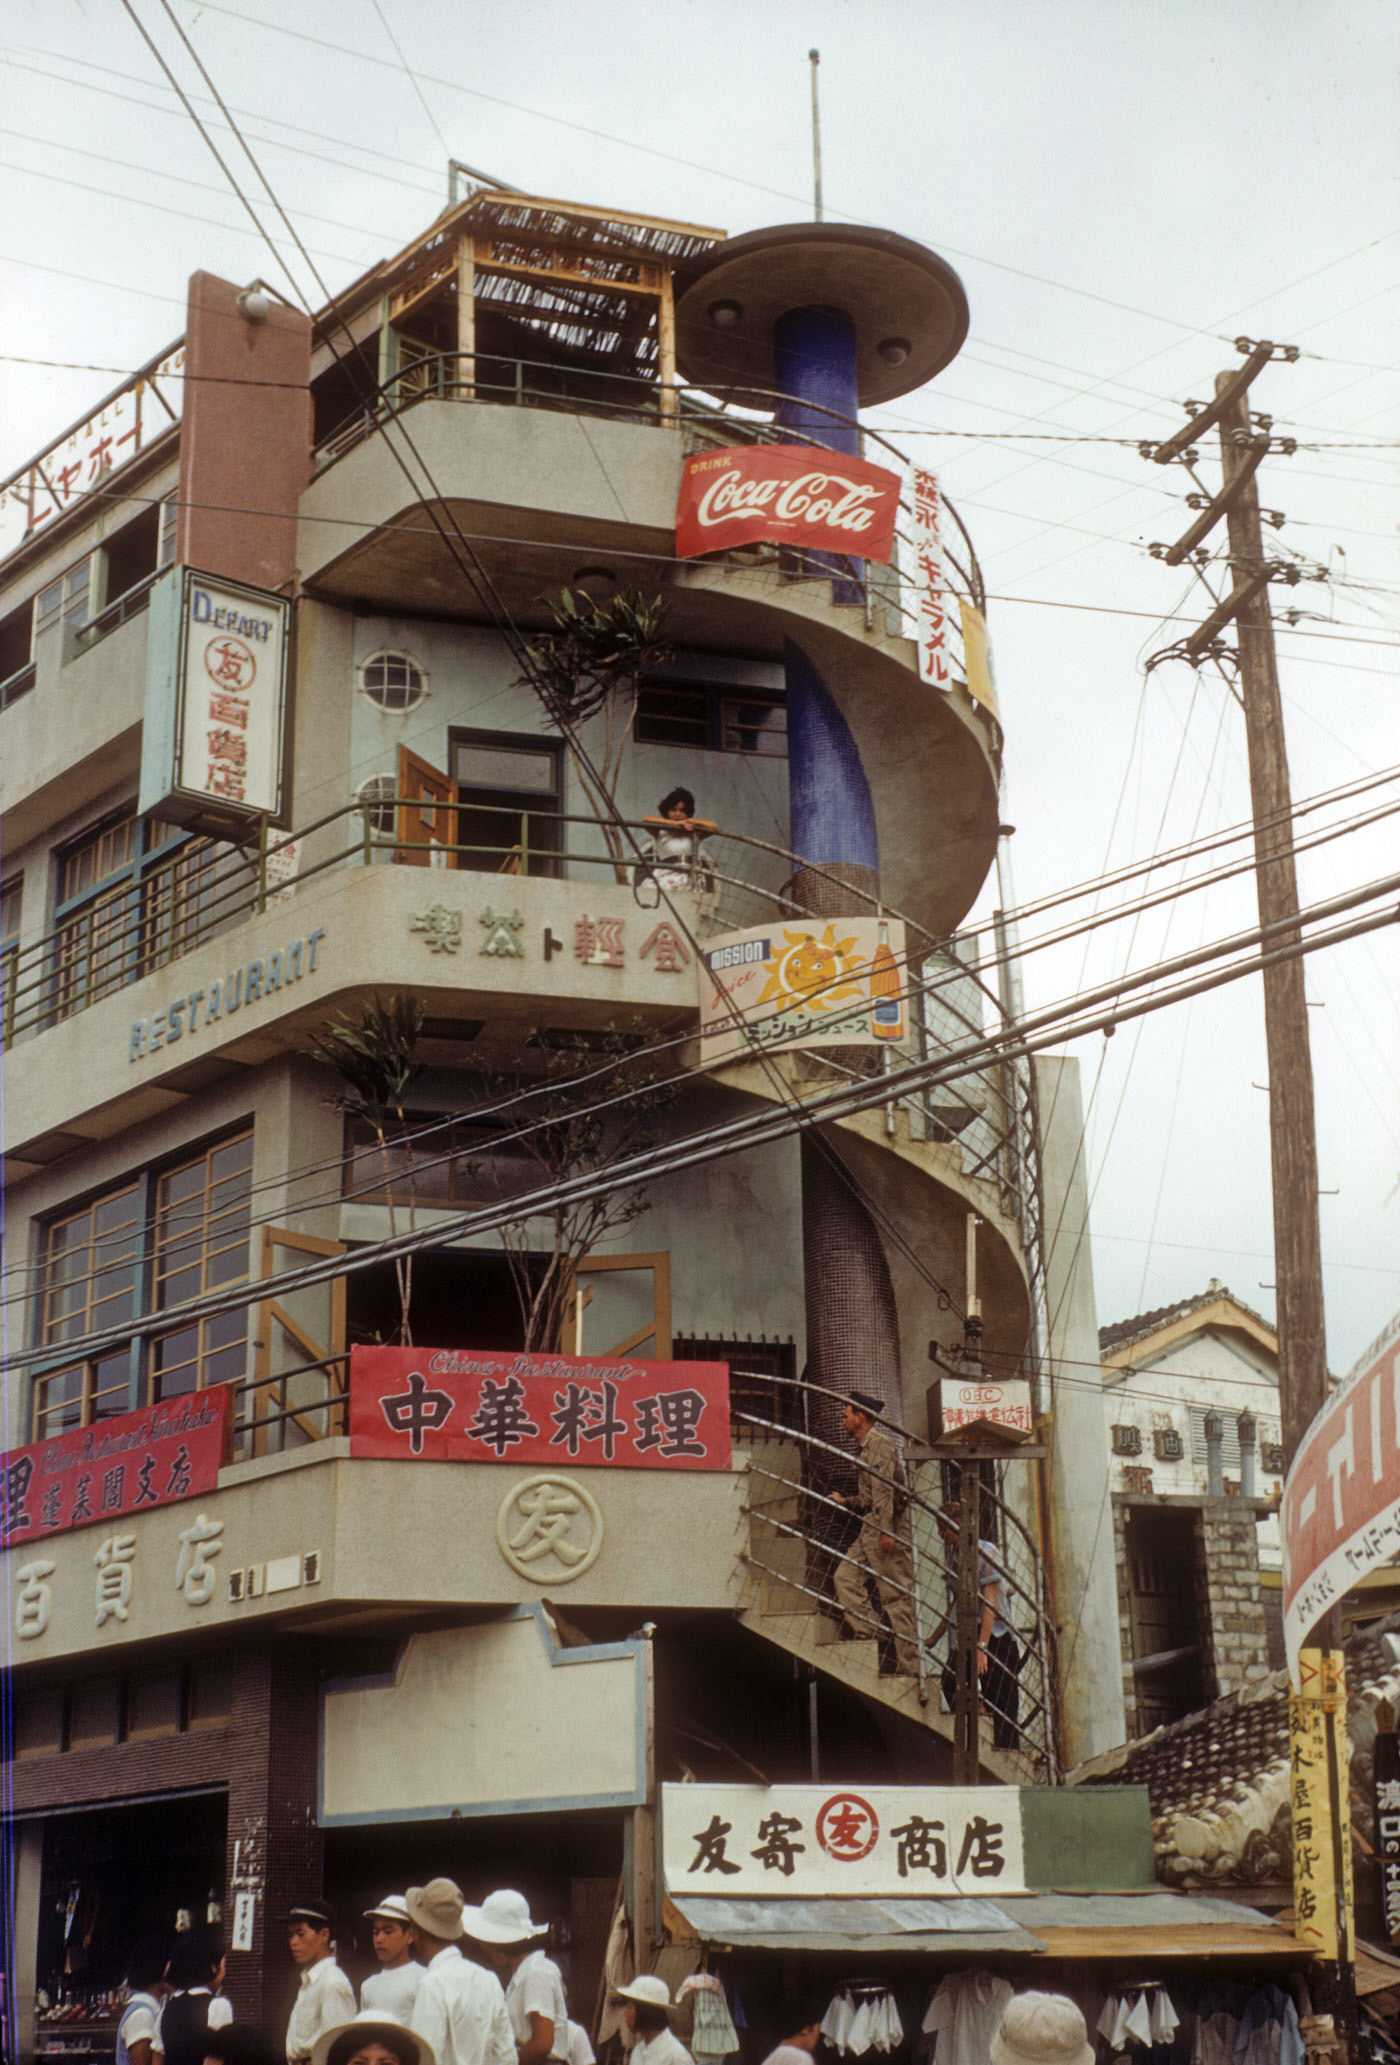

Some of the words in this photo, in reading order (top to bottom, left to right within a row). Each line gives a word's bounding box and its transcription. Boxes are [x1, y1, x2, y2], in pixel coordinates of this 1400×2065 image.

[690, 456, 732, 475] DRINK
[698, 470, 887, 532] Coca-Cola
[193, 590, 273, 643] DEPART
[205, 691, 250, 801] 百貨店
[129, 927, 326, 1063] RESTAURANT
[507, 1355, 647, 1382] Restaurant
[379, 1372, 707, 1461] 中華料理
[16, 1513, 224, 1639] 百貨店
[687, 1811, 806, 1876] 友寄
[890, 1815, 1006, 1879] 商店
